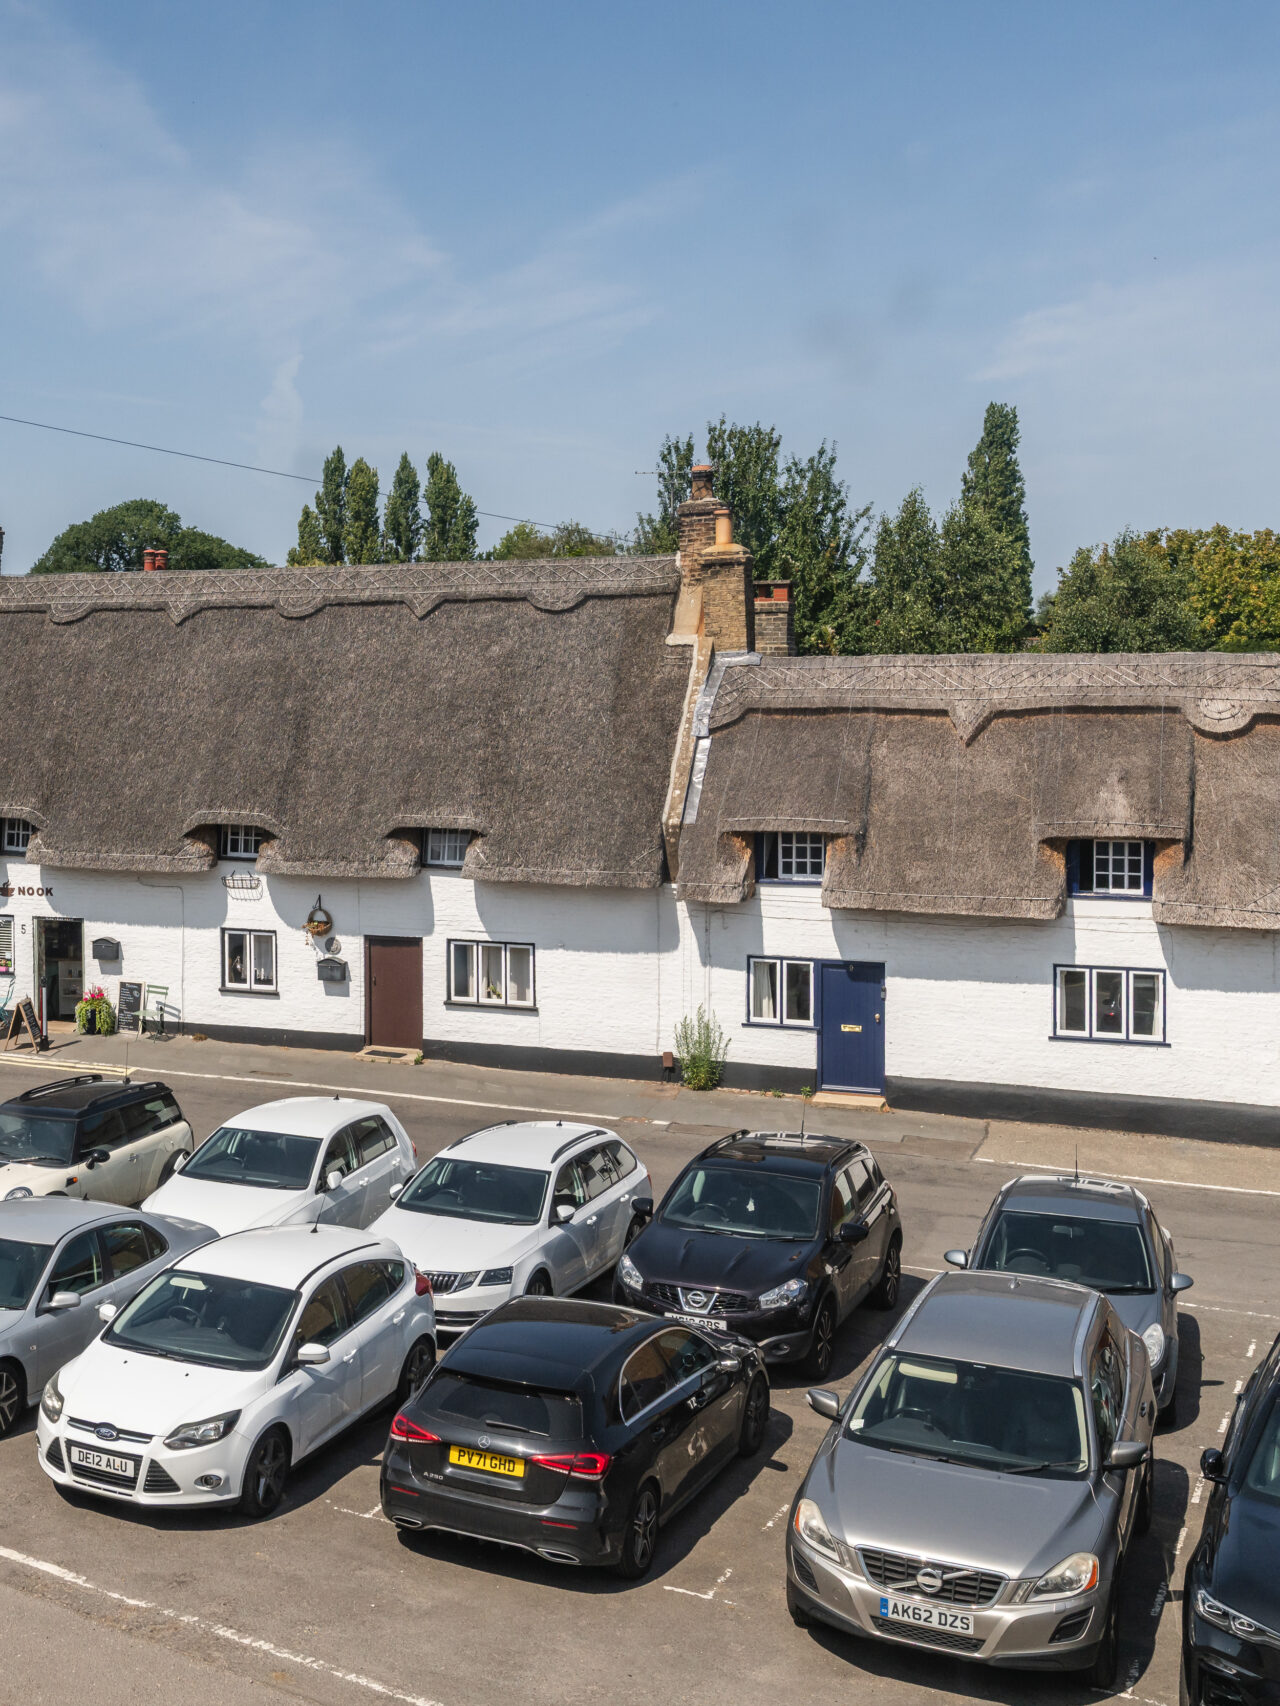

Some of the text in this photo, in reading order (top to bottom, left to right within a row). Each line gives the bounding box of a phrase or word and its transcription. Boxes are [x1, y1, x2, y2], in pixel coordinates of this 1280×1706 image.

[18, 886, 54, 897] NOOK
[20, 924, 27, 935] 5
[78, 1449, 128, 1473] DE12 ALU
[457, 1448, 516, 1473] PV71 GHD
[891, 1602, 970, 1631] AK62 DZS
